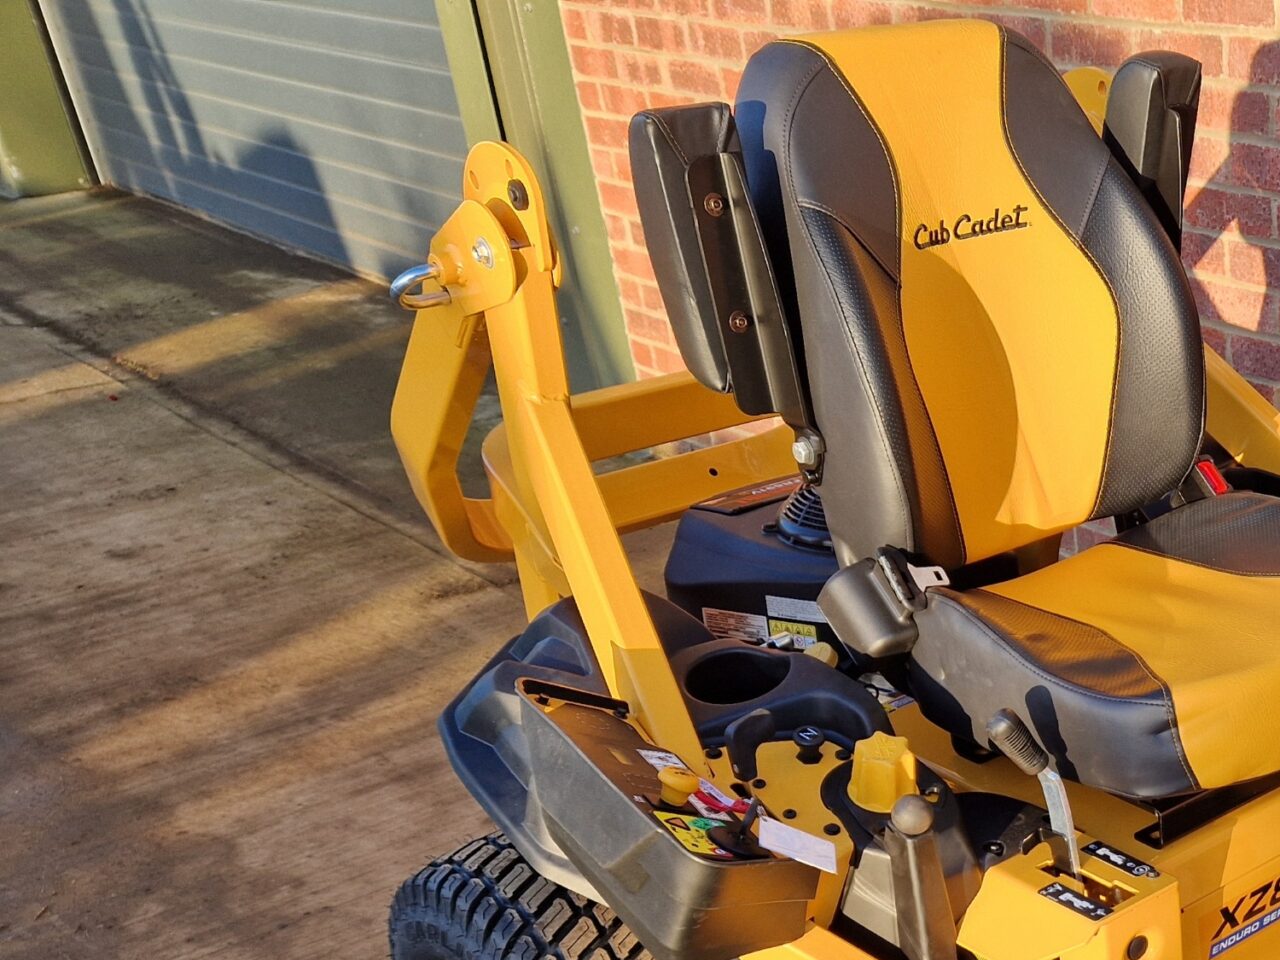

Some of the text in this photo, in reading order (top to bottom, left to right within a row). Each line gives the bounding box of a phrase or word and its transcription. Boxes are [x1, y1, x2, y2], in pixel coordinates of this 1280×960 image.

[913, 204, 1029, 250] Cub Cadet
[1211, 922, 1260, 955] ENDURO
